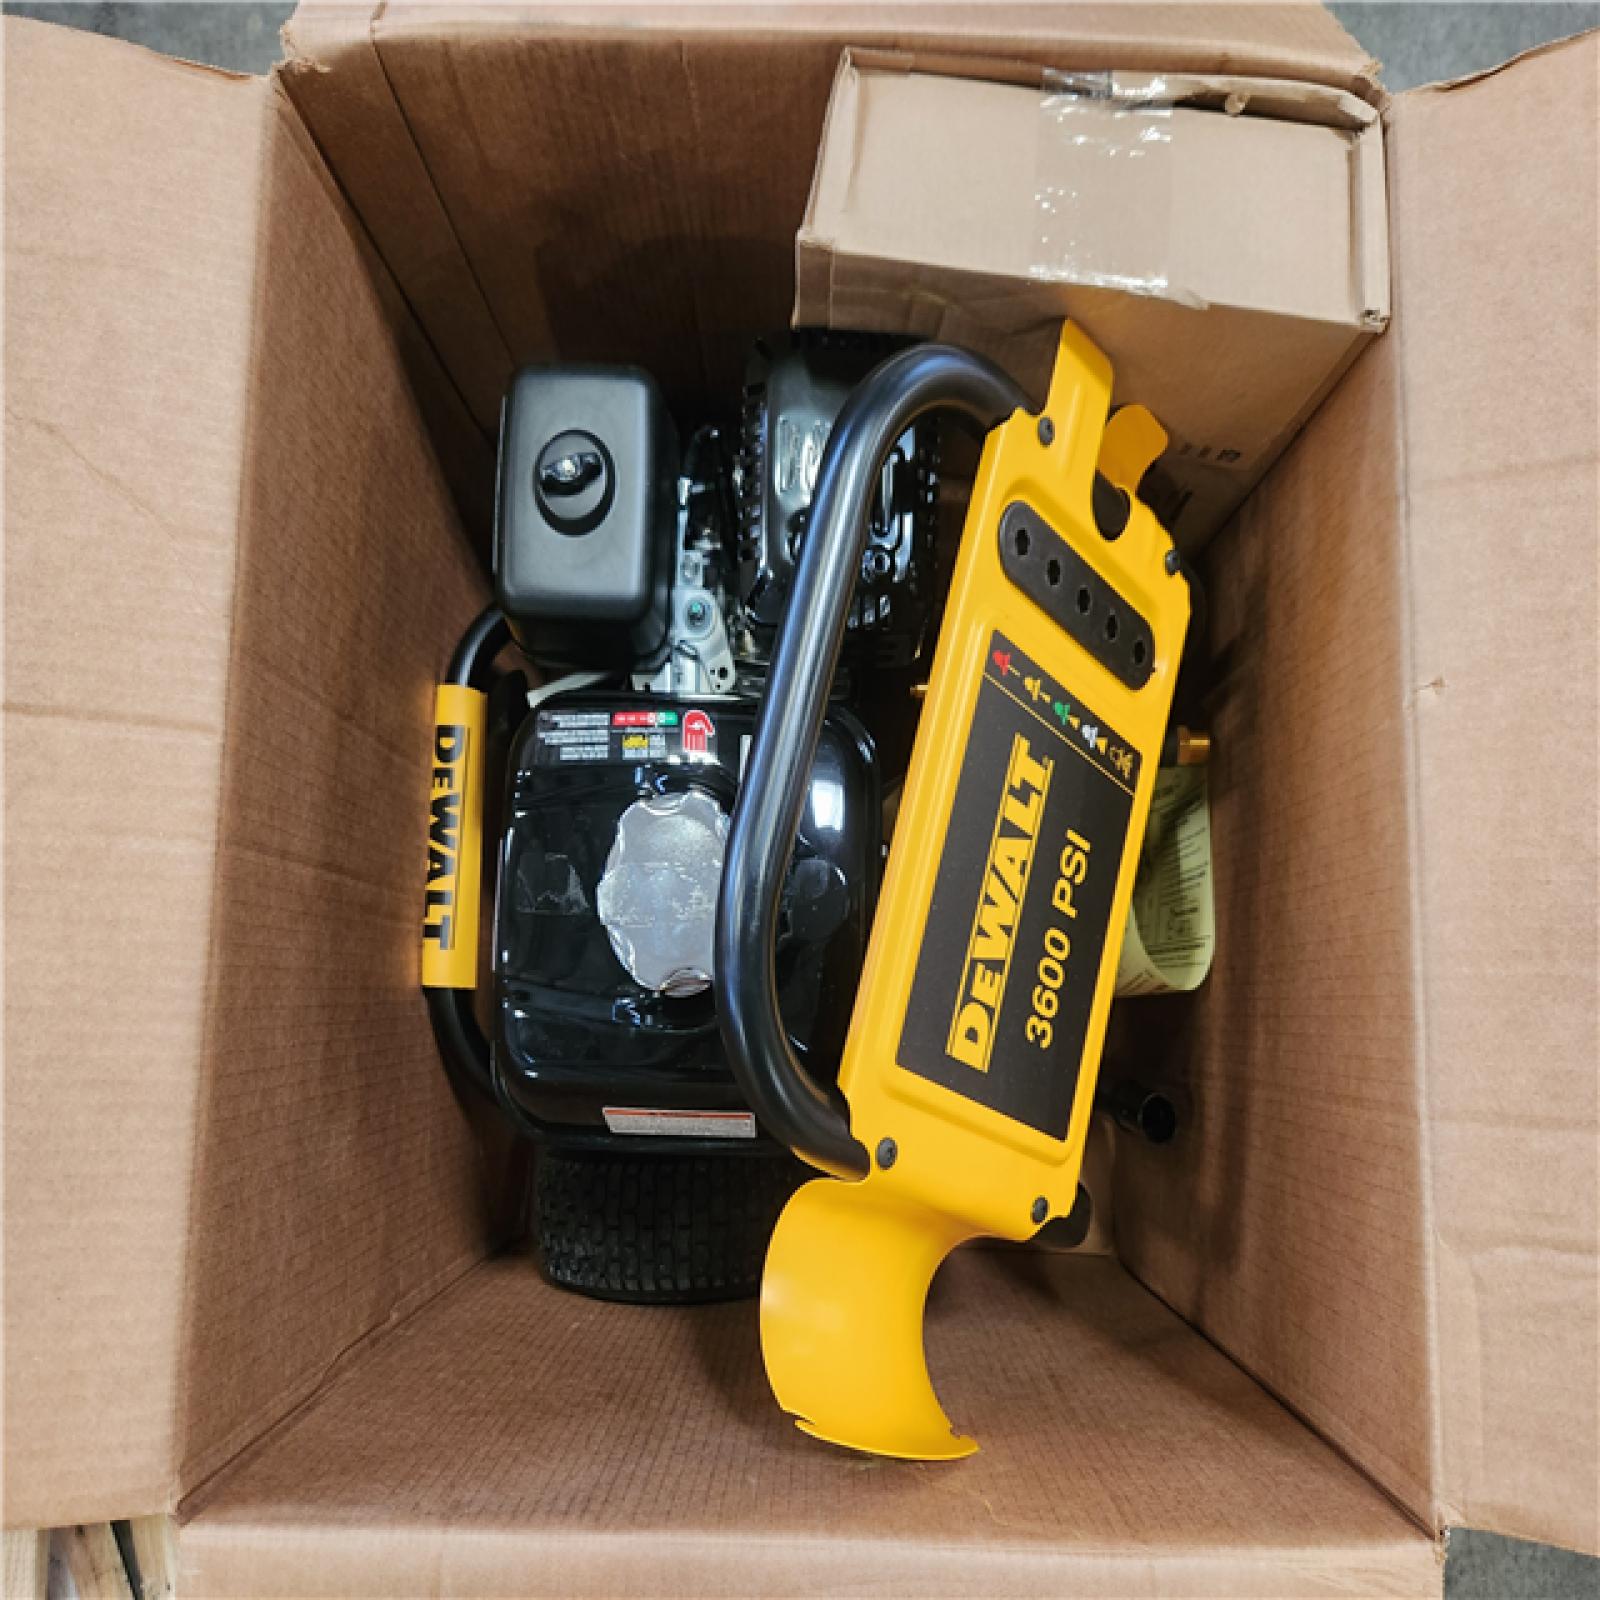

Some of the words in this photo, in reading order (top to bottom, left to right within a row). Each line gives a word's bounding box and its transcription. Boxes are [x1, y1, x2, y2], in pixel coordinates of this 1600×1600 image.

[423, 724, 466, 950] DEWALT
[946, 733, 1054, 1073] DEWALT
[1025, 927, 1072, 1049] 3600
[1052, 829, 1091, 919] PSI
